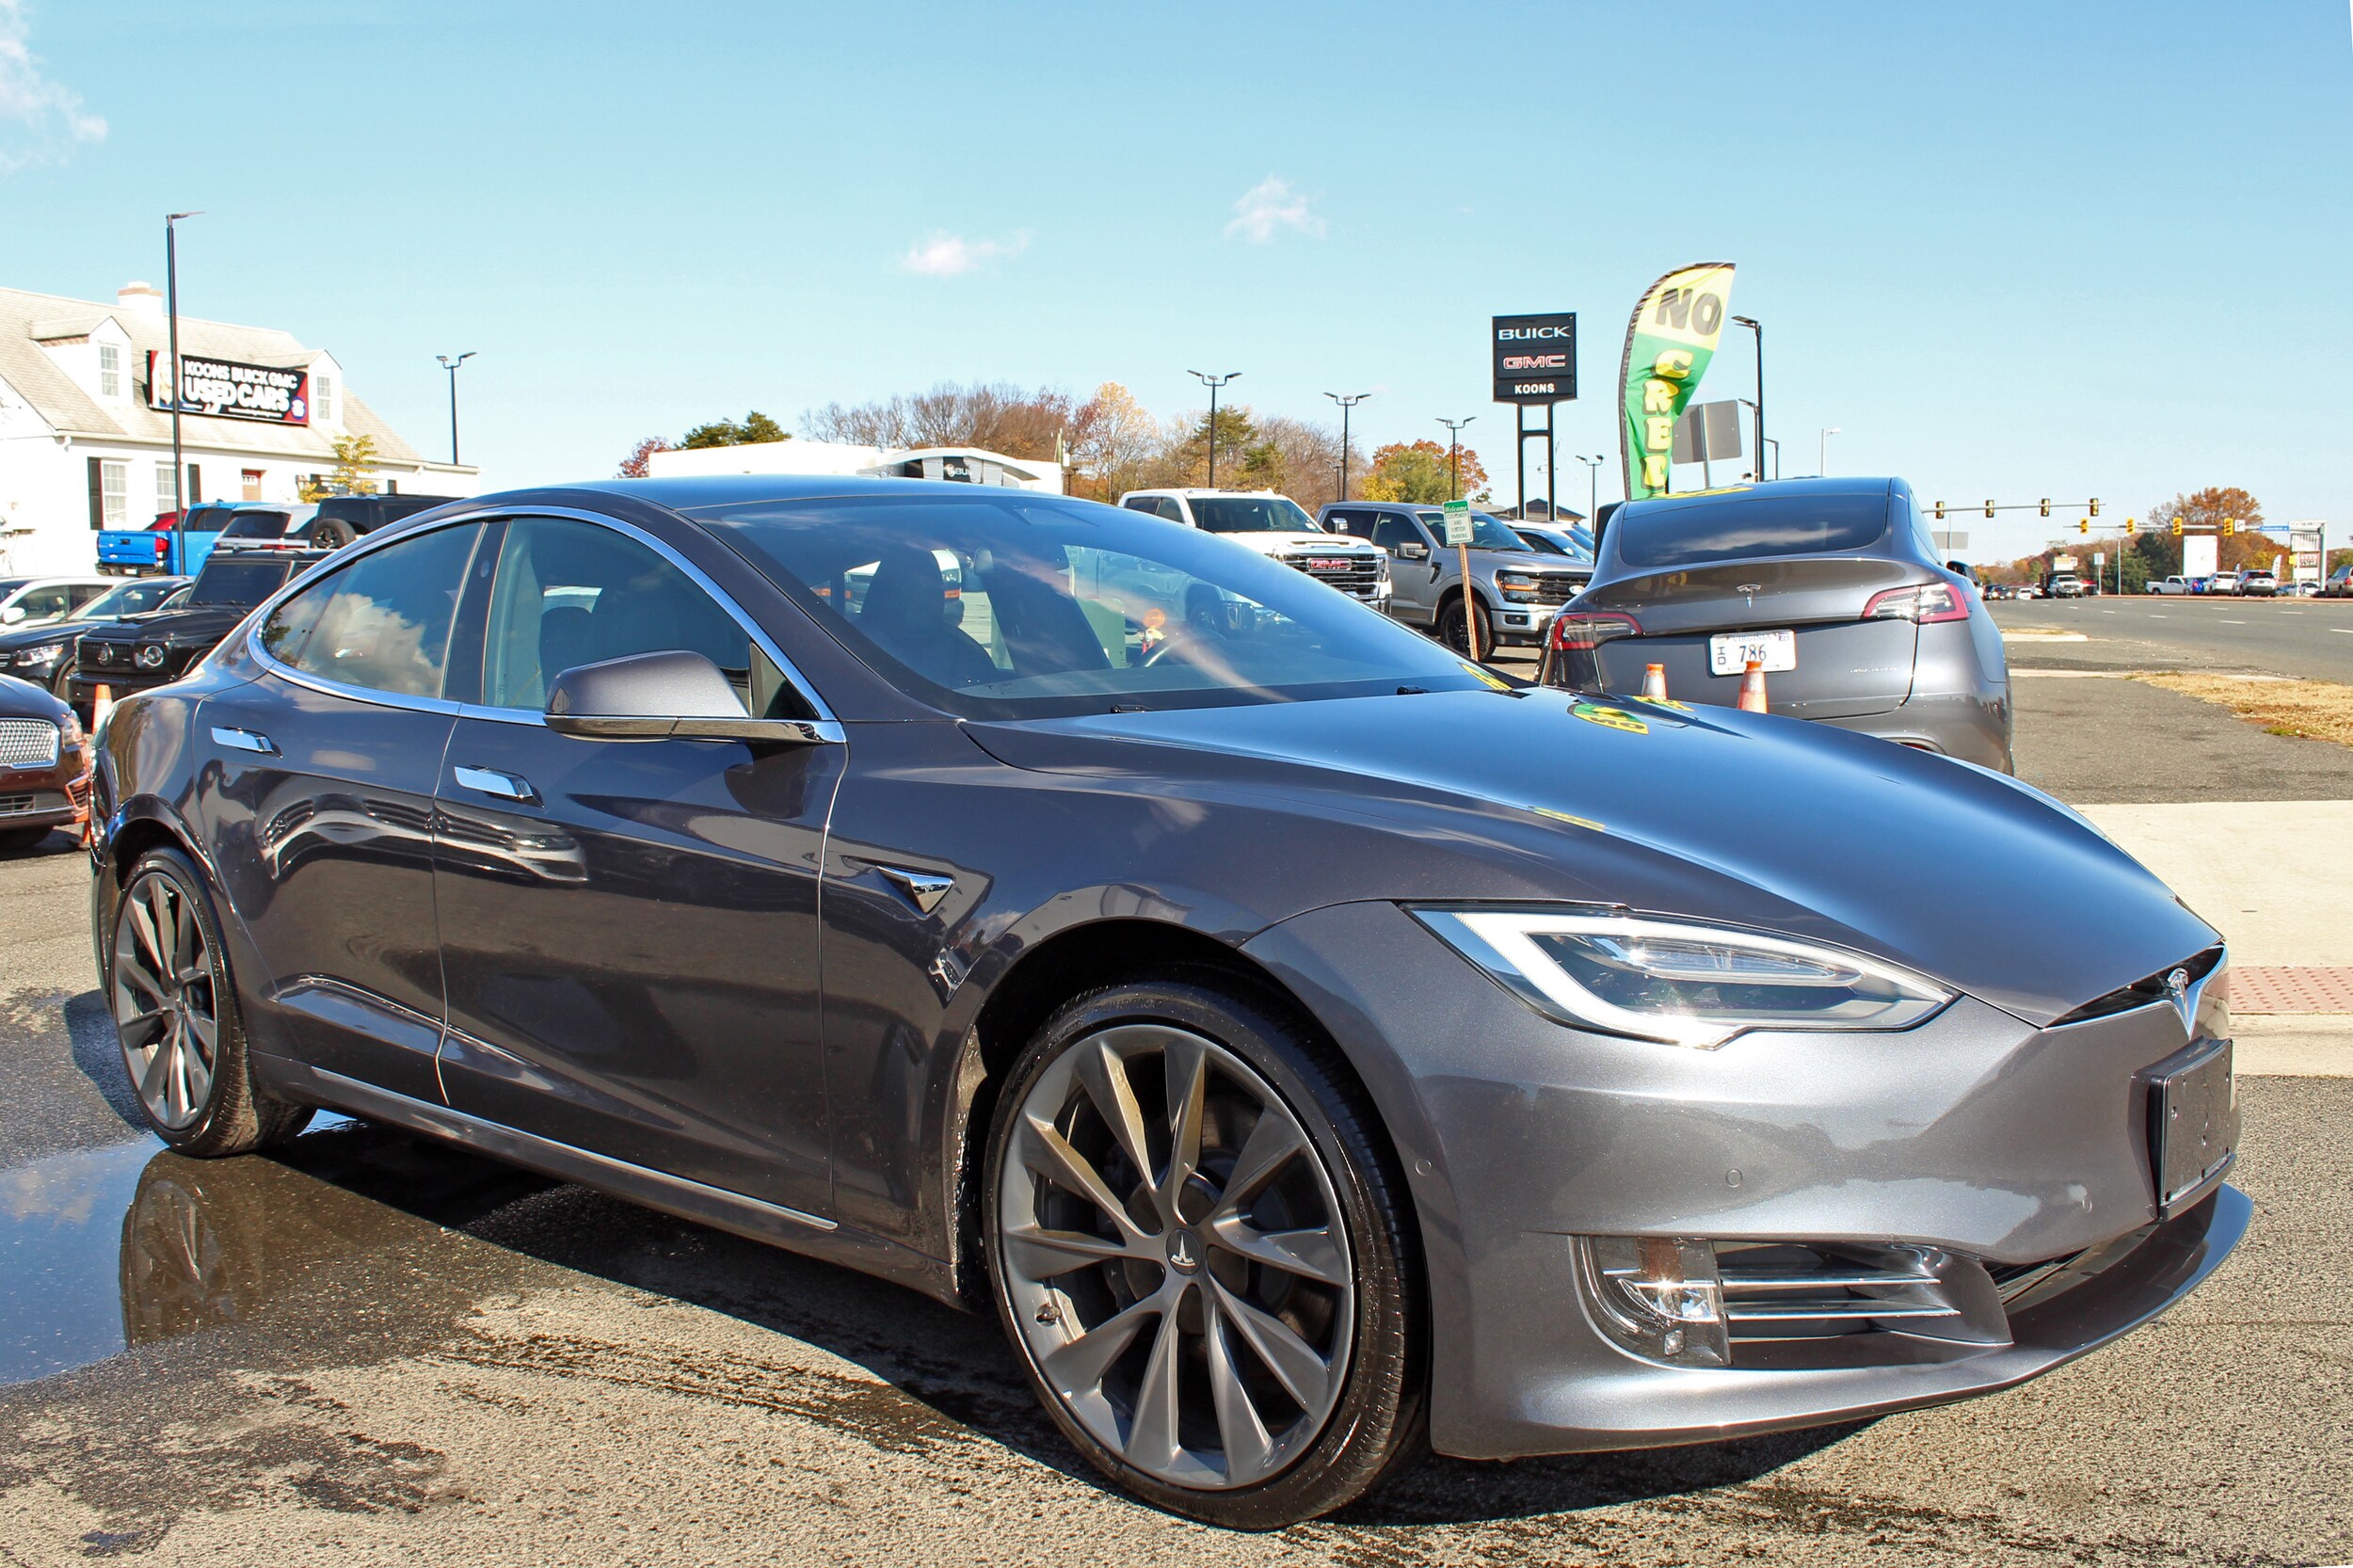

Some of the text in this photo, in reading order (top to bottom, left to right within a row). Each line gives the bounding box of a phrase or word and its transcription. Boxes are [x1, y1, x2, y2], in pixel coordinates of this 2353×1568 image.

[1656, 288, 1721, 336] NO
[1498, 326, 1570, 340] BUICK
[1503, 355, 1566, 369] GMC
[184, 360, 297, 390] KOONS BUICK GMC
[184, 376, 290, 412] USED CARS
[1513, 383, 1555, 394] KOONS
[1310, 559, 1349, 569] GMC
[1733, 633, 1771, 642] VIRGINIA
[1738, 644, 1767, 663] 786
